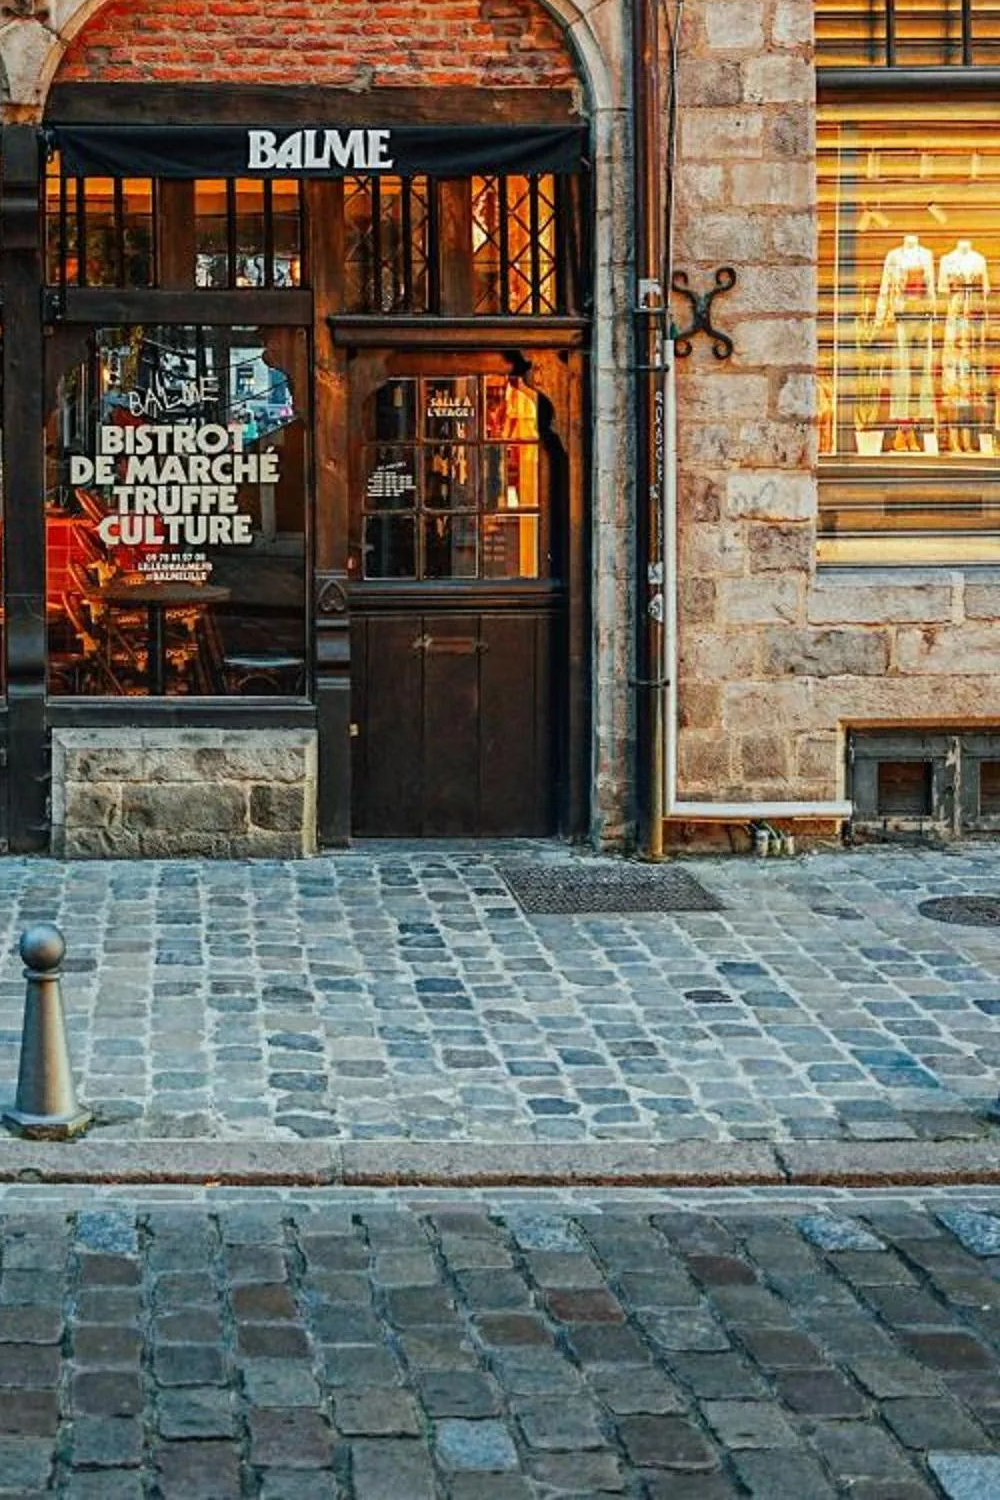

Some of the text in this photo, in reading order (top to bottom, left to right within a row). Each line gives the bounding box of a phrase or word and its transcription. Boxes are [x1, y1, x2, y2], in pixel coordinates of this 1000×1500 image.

[247, 129, 393, 169] BALME
[101, 424, 244, 454] BISTROT
[70, 446, 280, 485] DE MARCHÉ
[113, 485, 239, 514] TRUFFE
[99, 515, 253, 545] CULTURE
